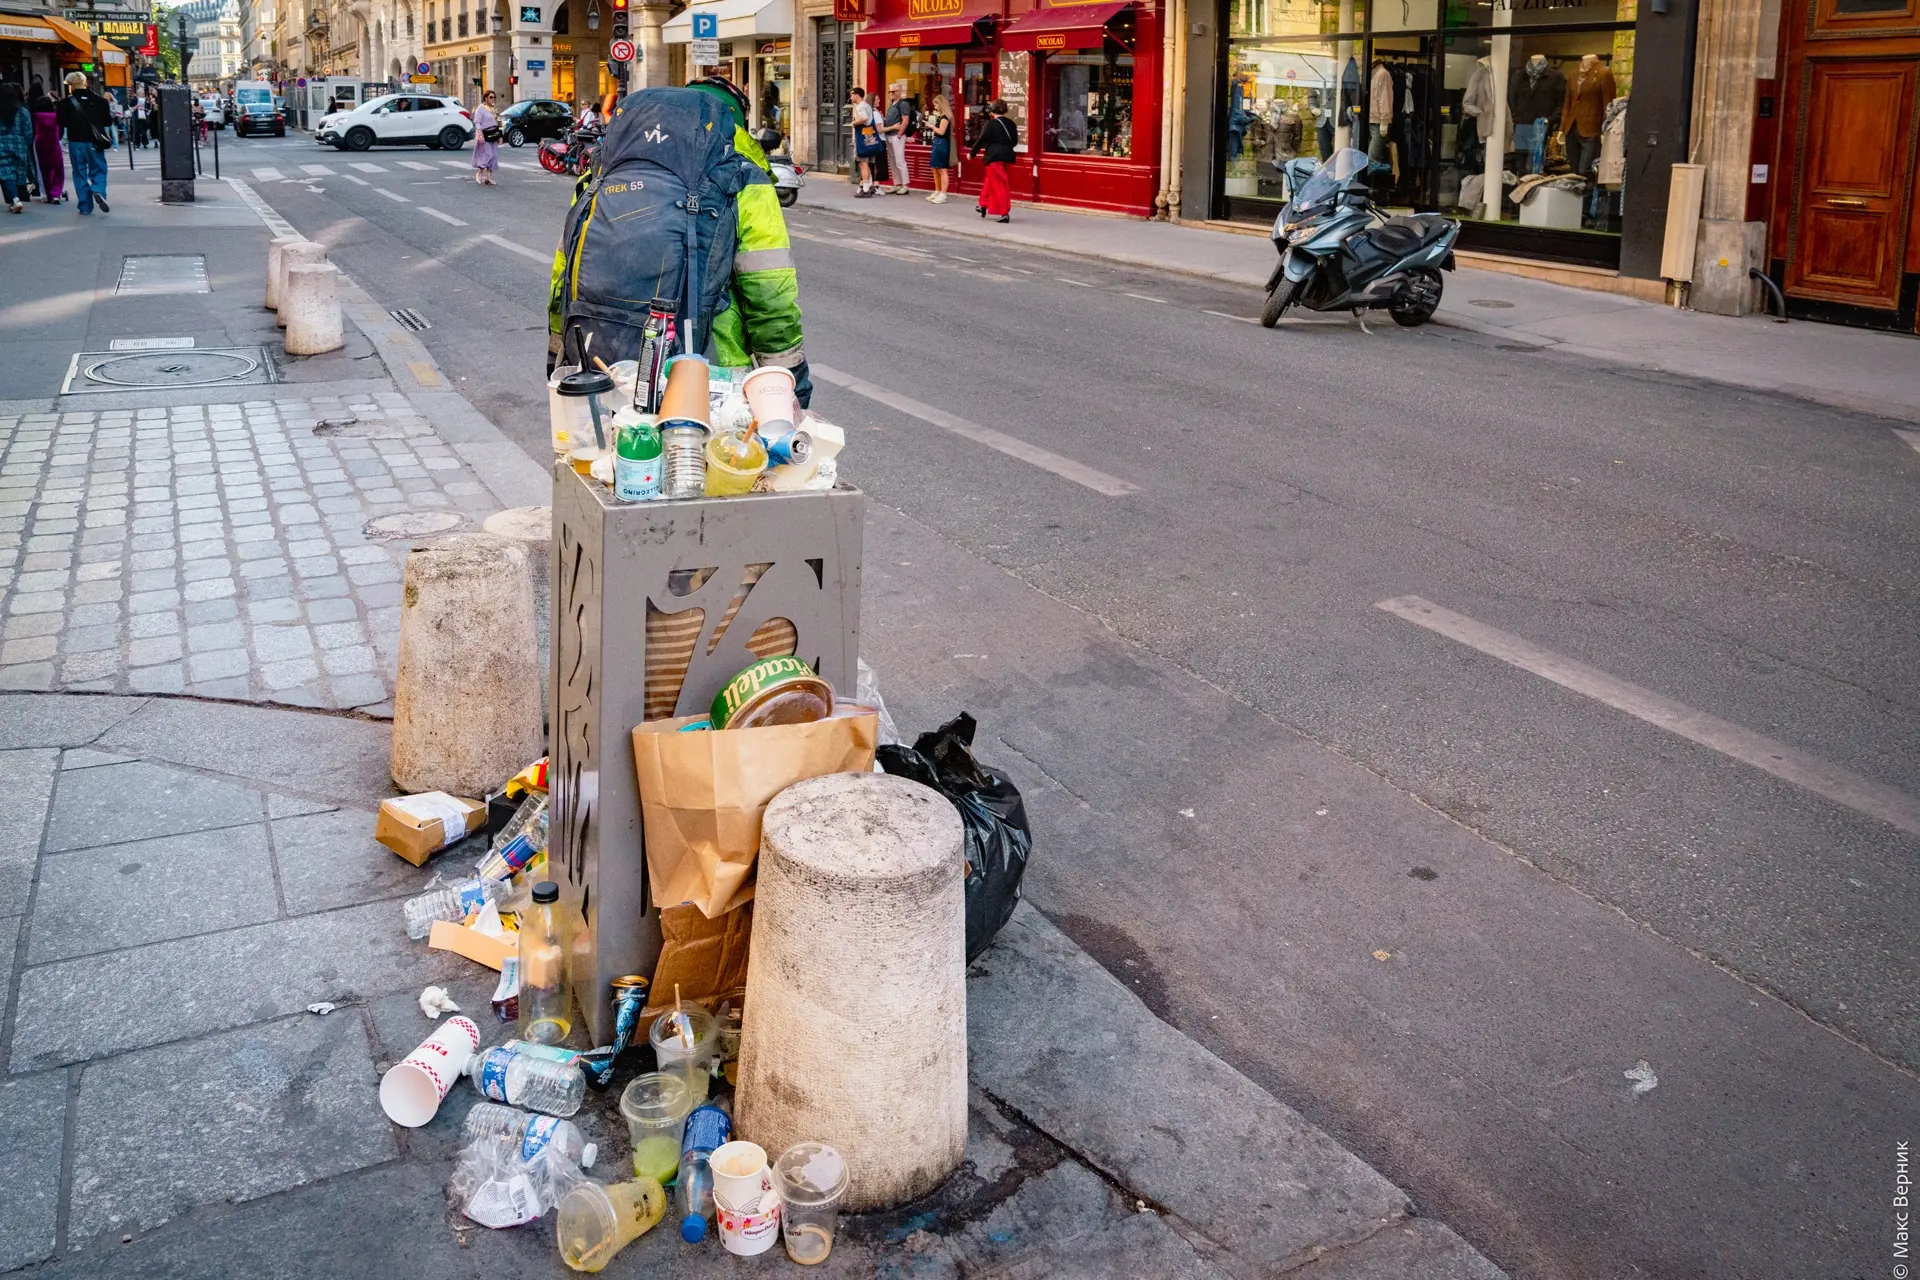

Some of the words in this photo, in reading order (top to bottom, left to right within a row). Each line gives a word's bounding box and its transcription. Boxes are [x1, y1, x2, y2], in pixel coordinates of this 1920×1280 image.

[911, 0, 960, 14] NICOLAS
[699, 18, 711, 34] P
[1038, 37, 1064, 46] NICOLAS
[605, 184, 628, 194] TREK
[630, 181, 644, 190] 55
[723, 657, 815, 714] Picadeli
